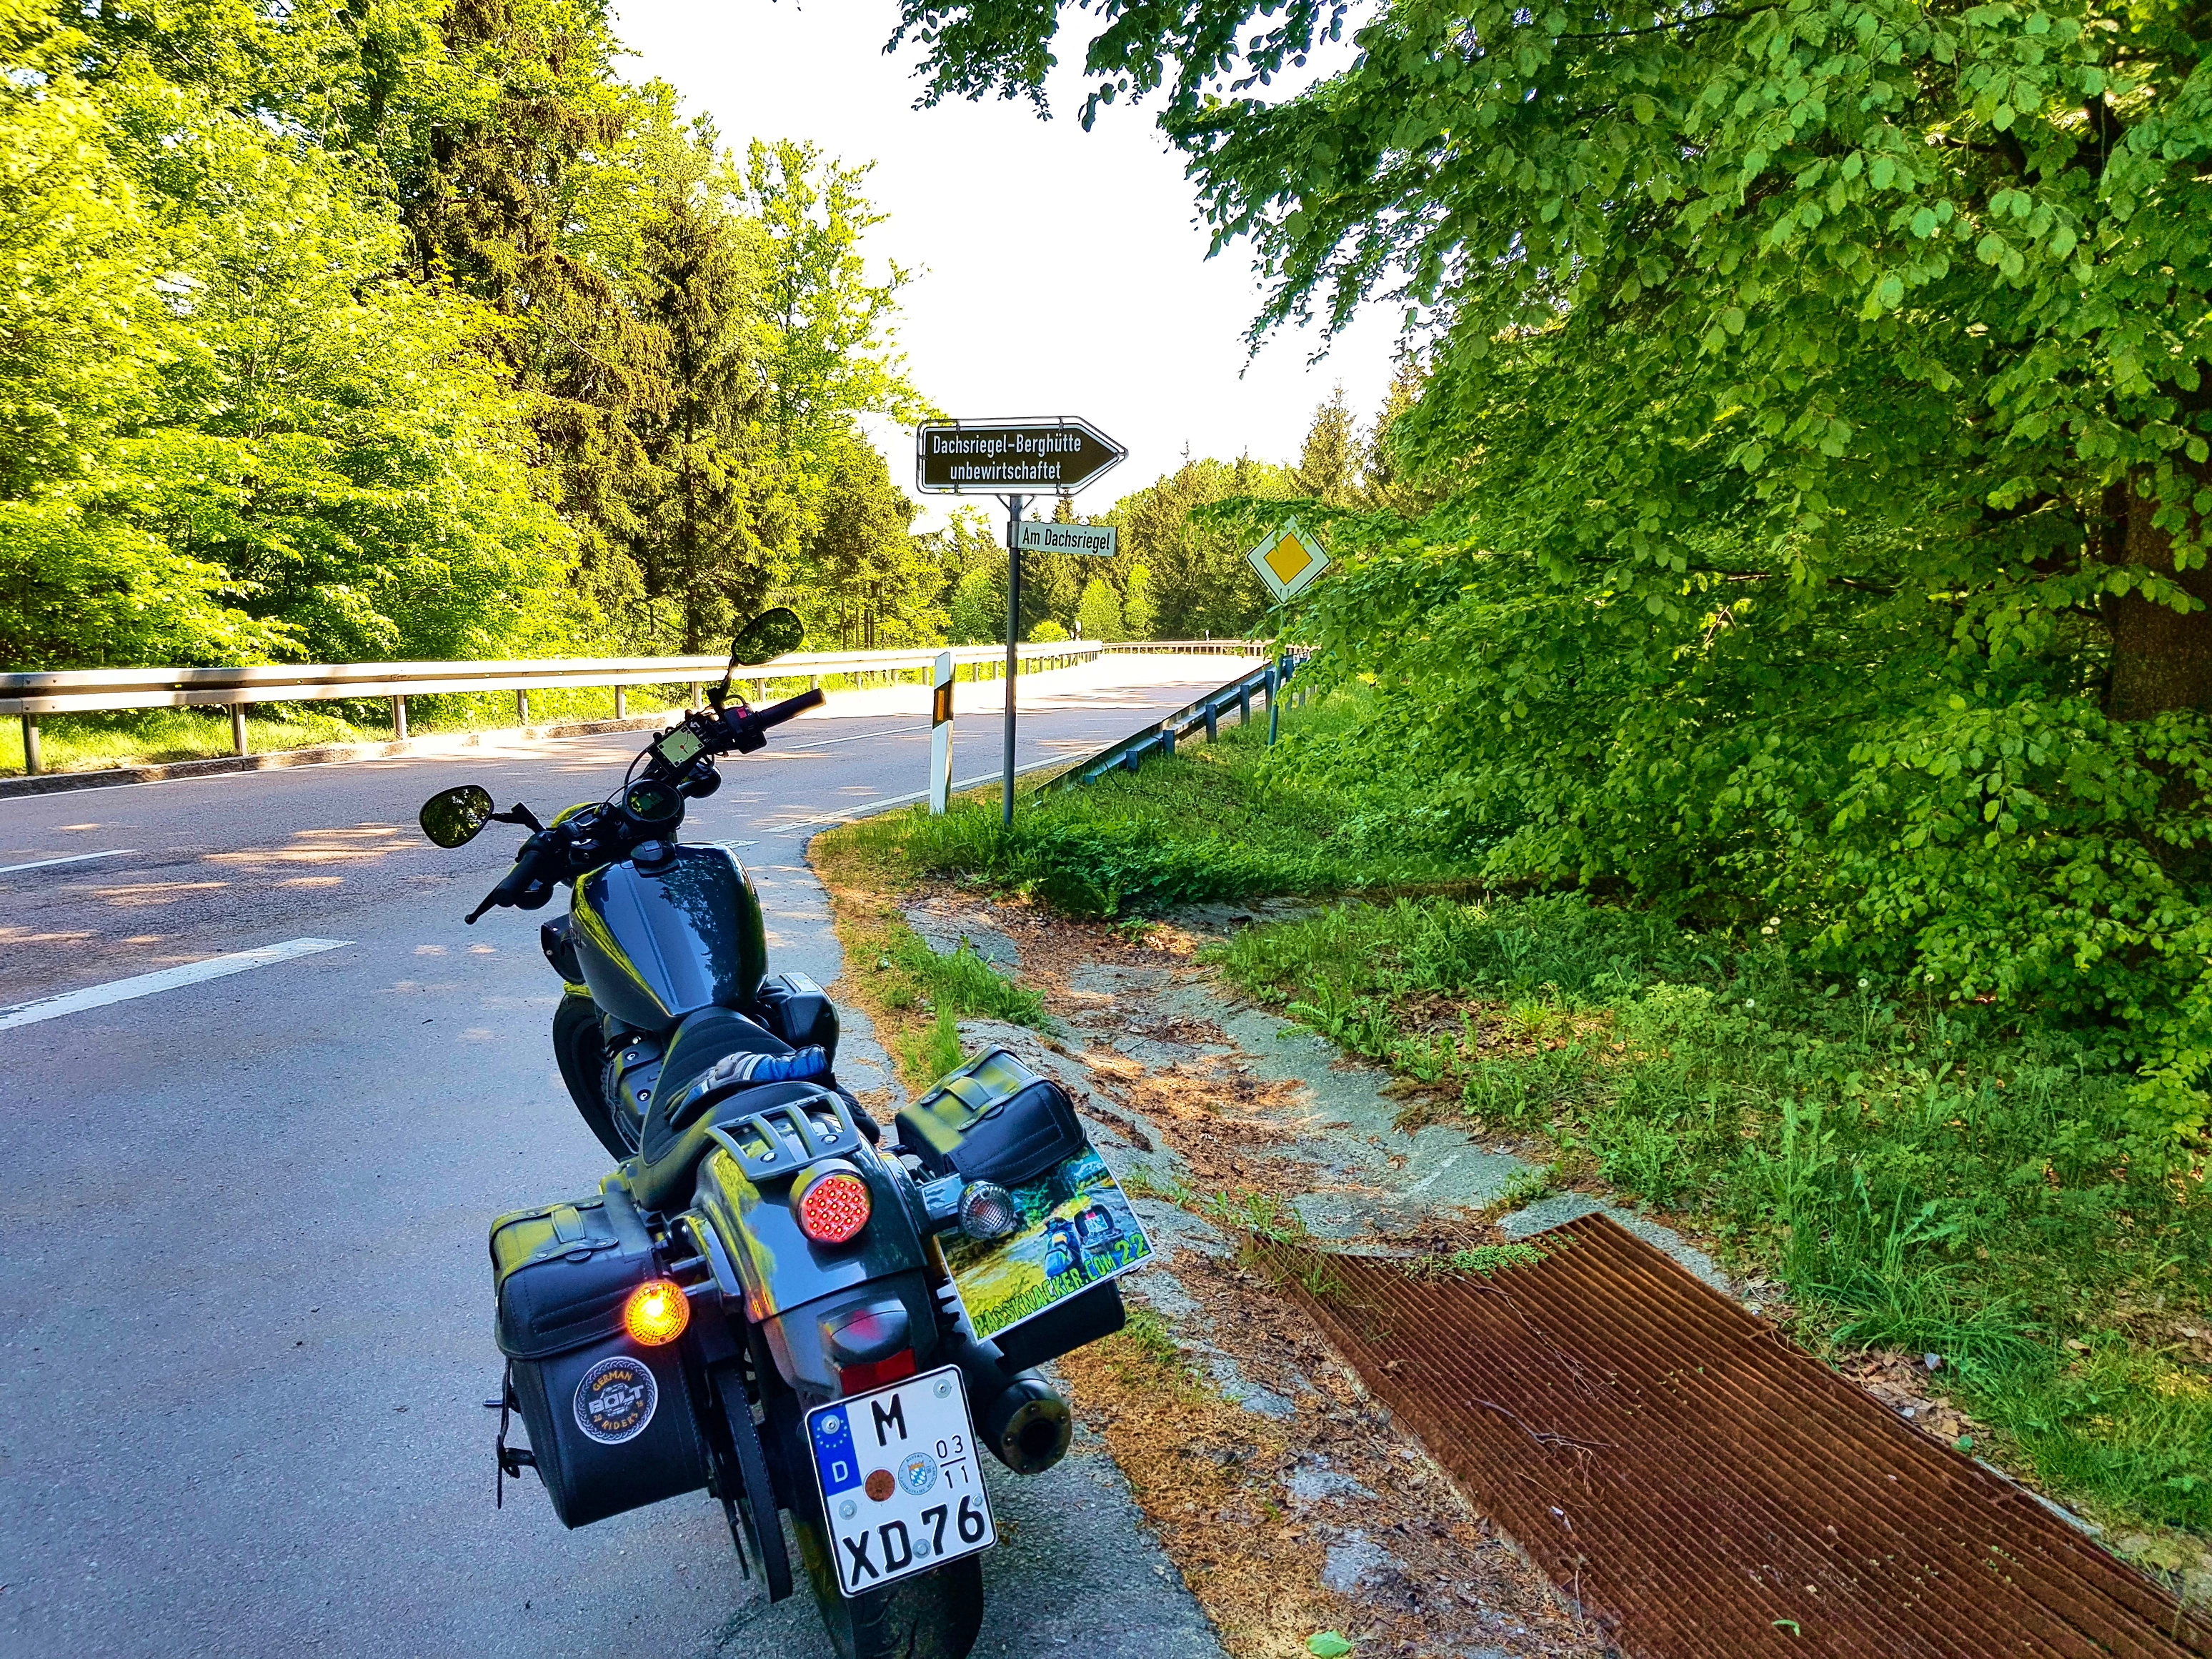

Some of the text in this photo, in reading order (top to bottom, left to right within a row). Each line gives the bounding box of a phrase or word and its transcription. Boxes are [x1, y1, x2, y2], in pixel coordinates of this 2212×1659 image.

[933, 434, 1082, 458] Dachsriegel-Berghütte
[950, 461, 1062, 480] unbewirtschaftet
[1022, 528, 1110, 554] Am Dachsriegel
[972, 1232, 1150, 1339] PASSKNACKER.COM 22
[592, 1370, 632, 1392] GERMAN
[588, 1385, 644, 1415] BOLT
[870, 1393, 908, 1447] M
[936, 1435, 964, 1459] 03
[831, 1460, 849, 1483] D
